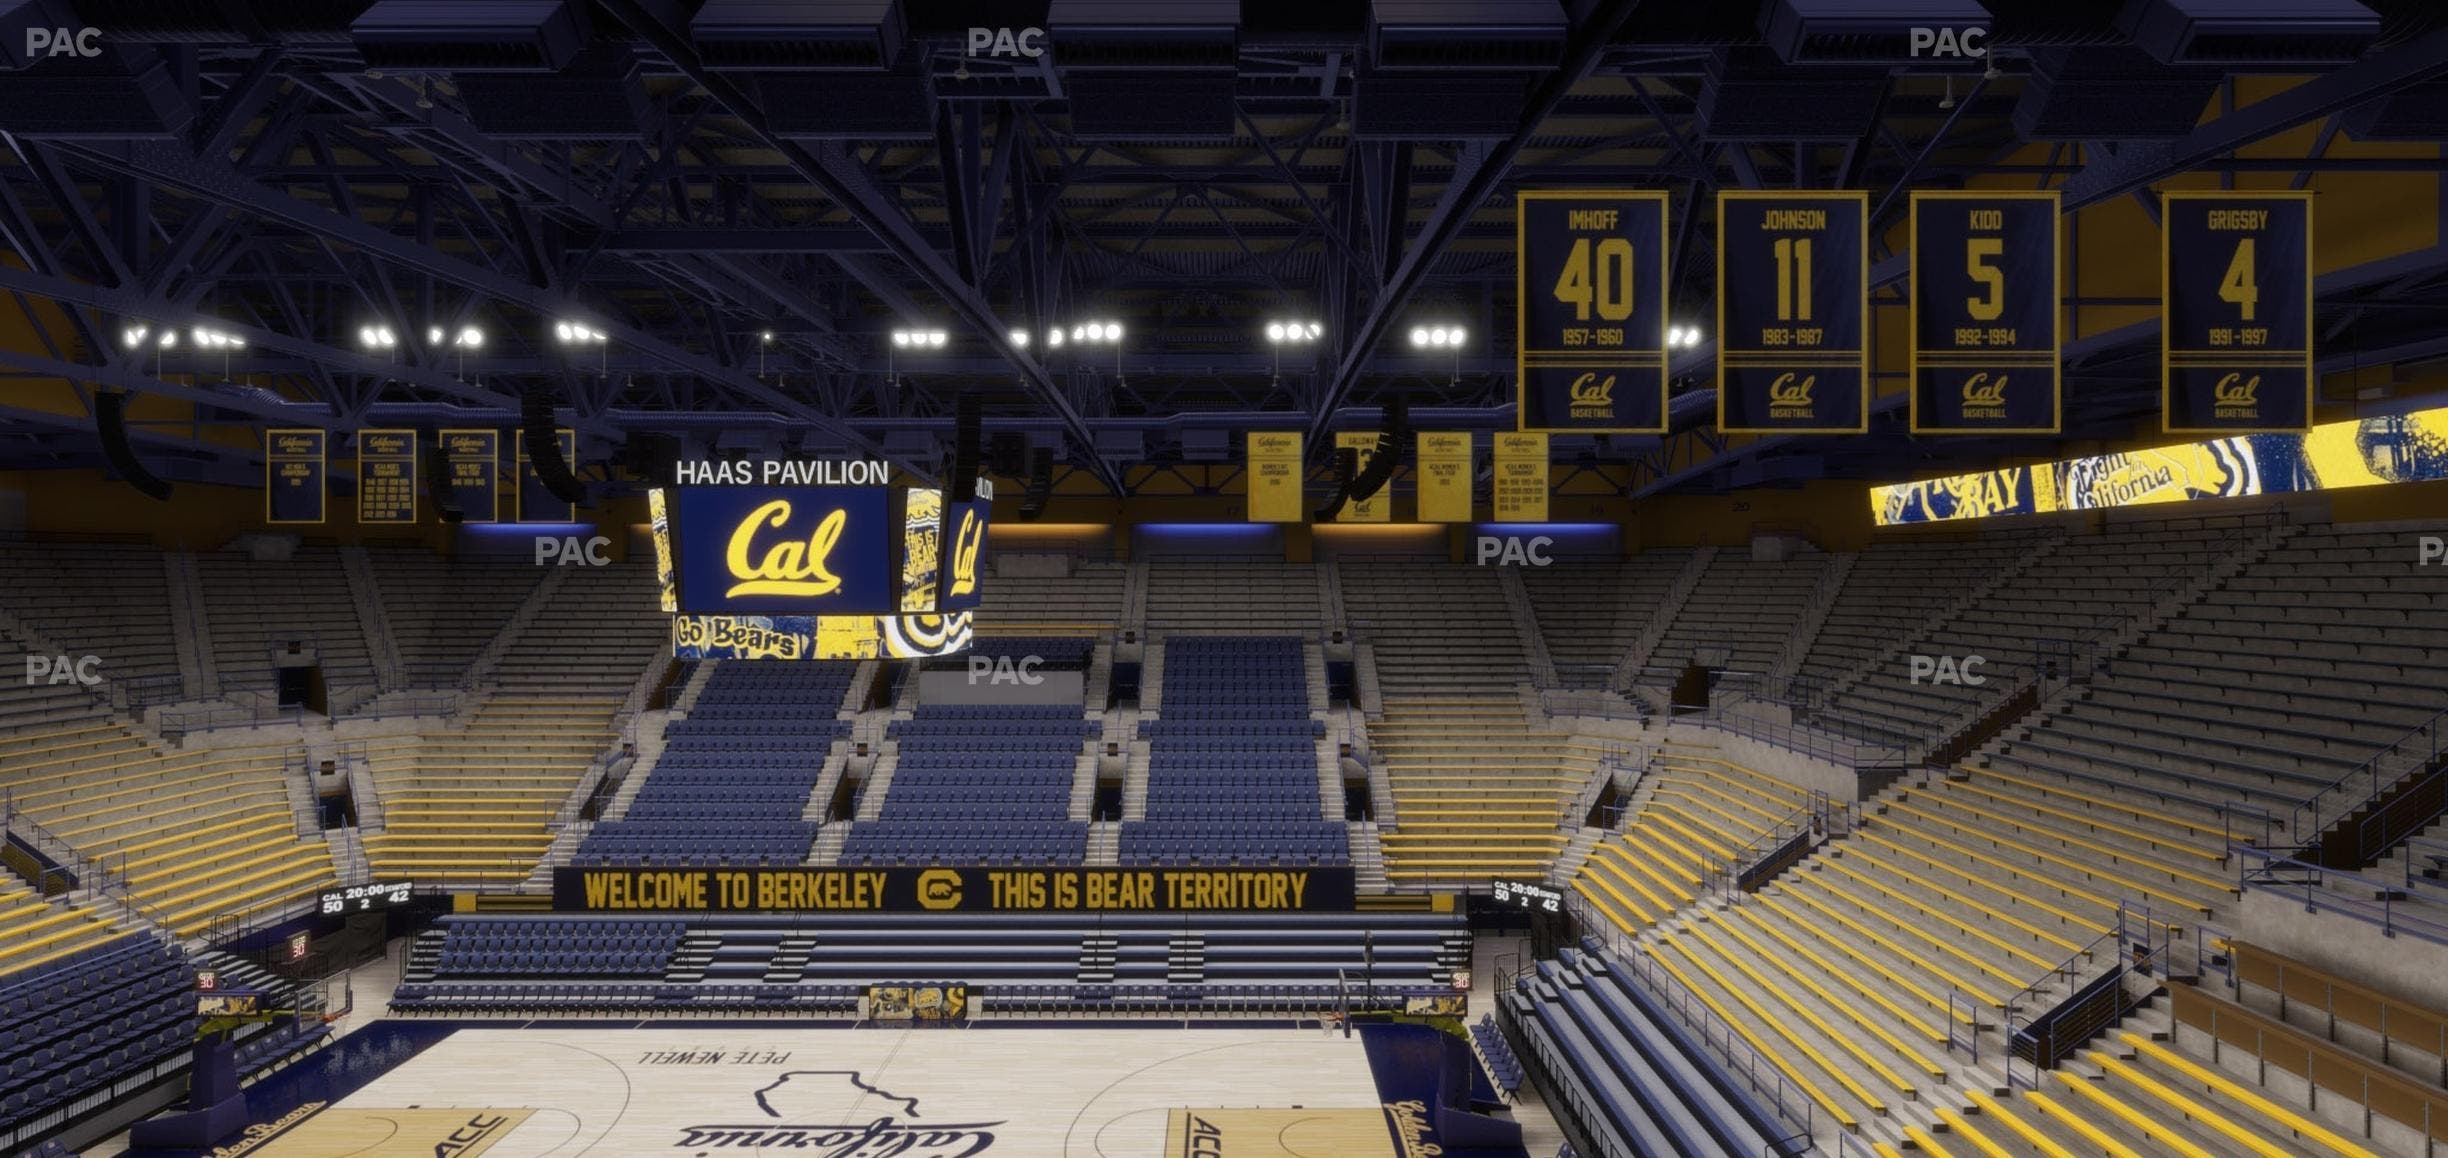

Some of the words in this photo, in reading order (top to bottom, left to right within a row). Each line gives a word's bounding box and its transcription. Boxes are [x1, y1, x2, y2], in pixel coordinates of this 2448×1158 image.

[1569, 210, 1618, 230] IMHOFF
[1762, 210, 1825, 230] JOHNSON
[1969, 210, 2003, 230] KIDD
[2208, 210, 2268, 230] GRIGSBY
[1553, 238, 1633, 320] 40
[1774, 238, 1811, 320] 11
[1967, 238, 2004, 321] 5
[2218, 238, 2258, 320] 4
[1563, 328, 1623, 345] 1957-1960
[1762, 328, 1823, 345] 1983-1987
[1955, 328, 2016, 345] 1992-1994
[2209, 328, 2268, 345] 1991-1997
[1569, 372, 1616, 406] Cal
[1769, 372, 1815, 406] Cal
[1961, 372, 2008, 406] Cal
[2214, 372, 2261, 406] Cal
[1570, 407, 1614, 418] BASKETBALL
[1770, 407, 1814, 418] BASKETBALL
[1962, 407, 2007, 418] BASKETBALL
[2214, 407, 2259, 418] BASKETBALL
[677, 461, 752, 484] HAAS
[764, 461, 889, 484] PAVILION
[725, 499, 847, 599] Cal
[950, 508, 983, 597] Cal
[676, 617, 703, 644] Go
[714, 615, 795, 657] Bears
[322, 893, 344, 902] CAL
[346, 884, 385, 900] 20:00
[388, 890, 409, 903] 42
[584, 872, 707, 909] WELCOME
[716, 872, 750, 909] TO
[757, 872, 887, 909] BERKELEY
[988, 872, 1046, 909] THIS
[1054, 872, 1078, 909] IS
[1086, 872, 1155, 909] BEAR
[1163, 872, 1308, 909] TERRITORY
[1494, 880, 1510, 891] CAL
[1510, 882, 1539, 897] 20:00
[1494, 888, 1510, 902] 50
[322, 900, 344, 914] 50
[360, 898, 370, 910] 2
[1521, 896, 1529, 907] 2
[1542, 898, 1559, 912] 42
[293, 943, 305, 958] 30
[200, 979, 214, 989] 30
[635, 1050, 727, 1065] NEWELL
[733, 1051, 792, 1065] PETE
[434, 1114, 508, 1158] ACC
[674, 1117, 1008, 1158] California
